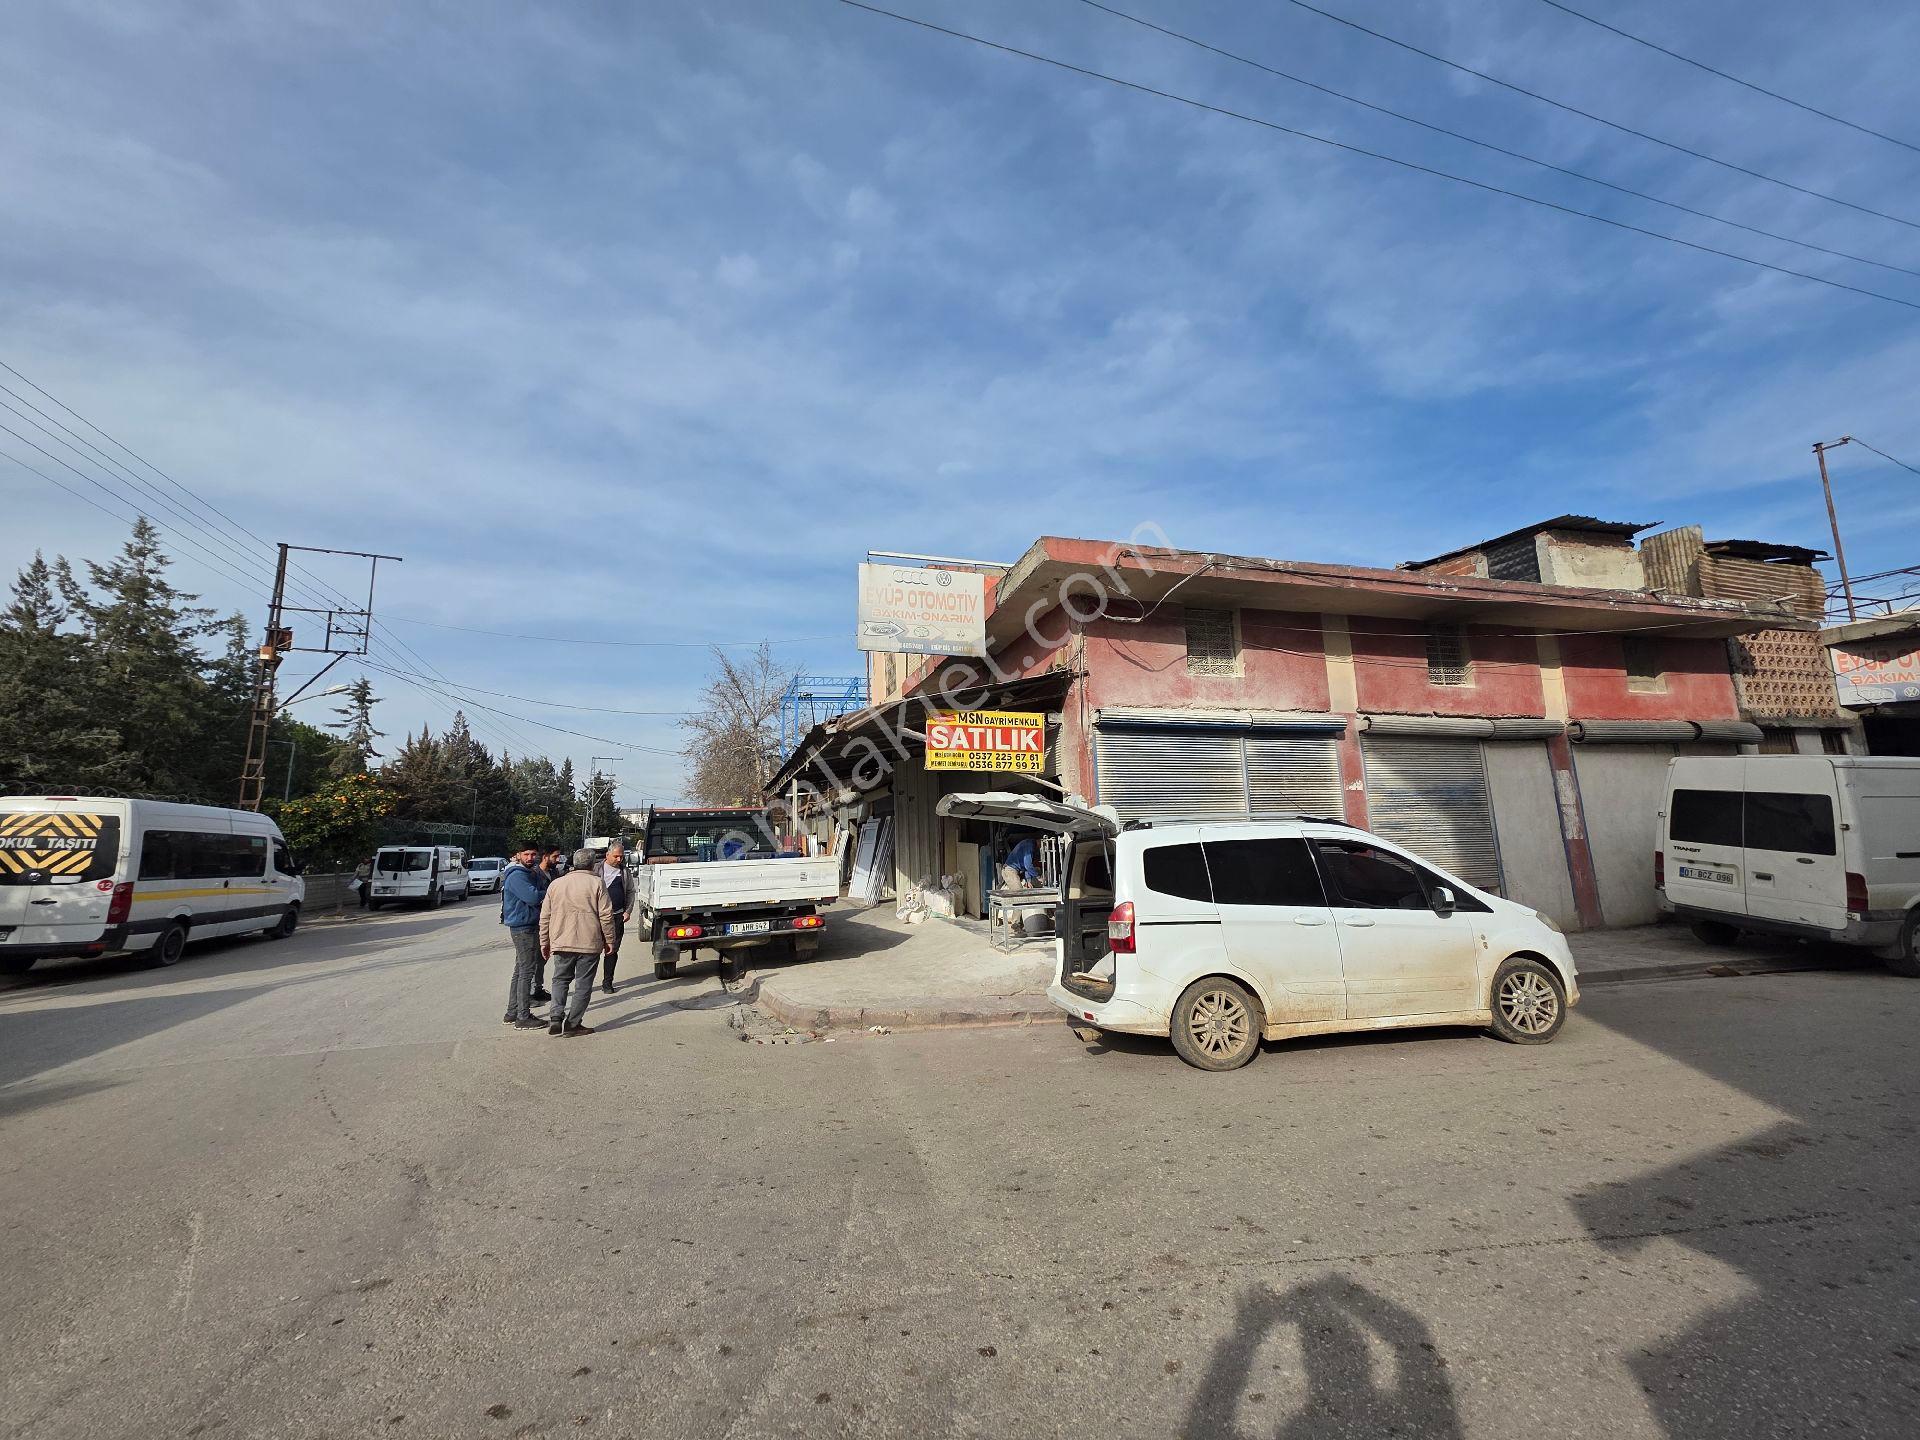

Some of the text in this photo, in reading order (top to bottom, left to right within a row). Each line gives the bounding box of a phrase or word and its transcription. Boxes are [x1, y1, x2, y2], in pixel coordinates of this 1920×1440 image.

[865, 583, 978, 613] EYÜP OTOMOTİV
[872, 608, 975, 624] BAKIM-ONARIM
[958, 712, 1040, 727] MSN GAYRİMENKUL
[930, 725, 1039, 751] SATILIK
[968, 752, 993, 760] 0537
[995, 753, 1012, 761] 225
[1015, 753, 1027, 761] 67
[968, 761, 1040, 770] 0536 877 99 21
[47, 837, 98, 850] TAŞITI
[1684, 868, 1693, 877] 01
[731, 924, 739, 932] 01
